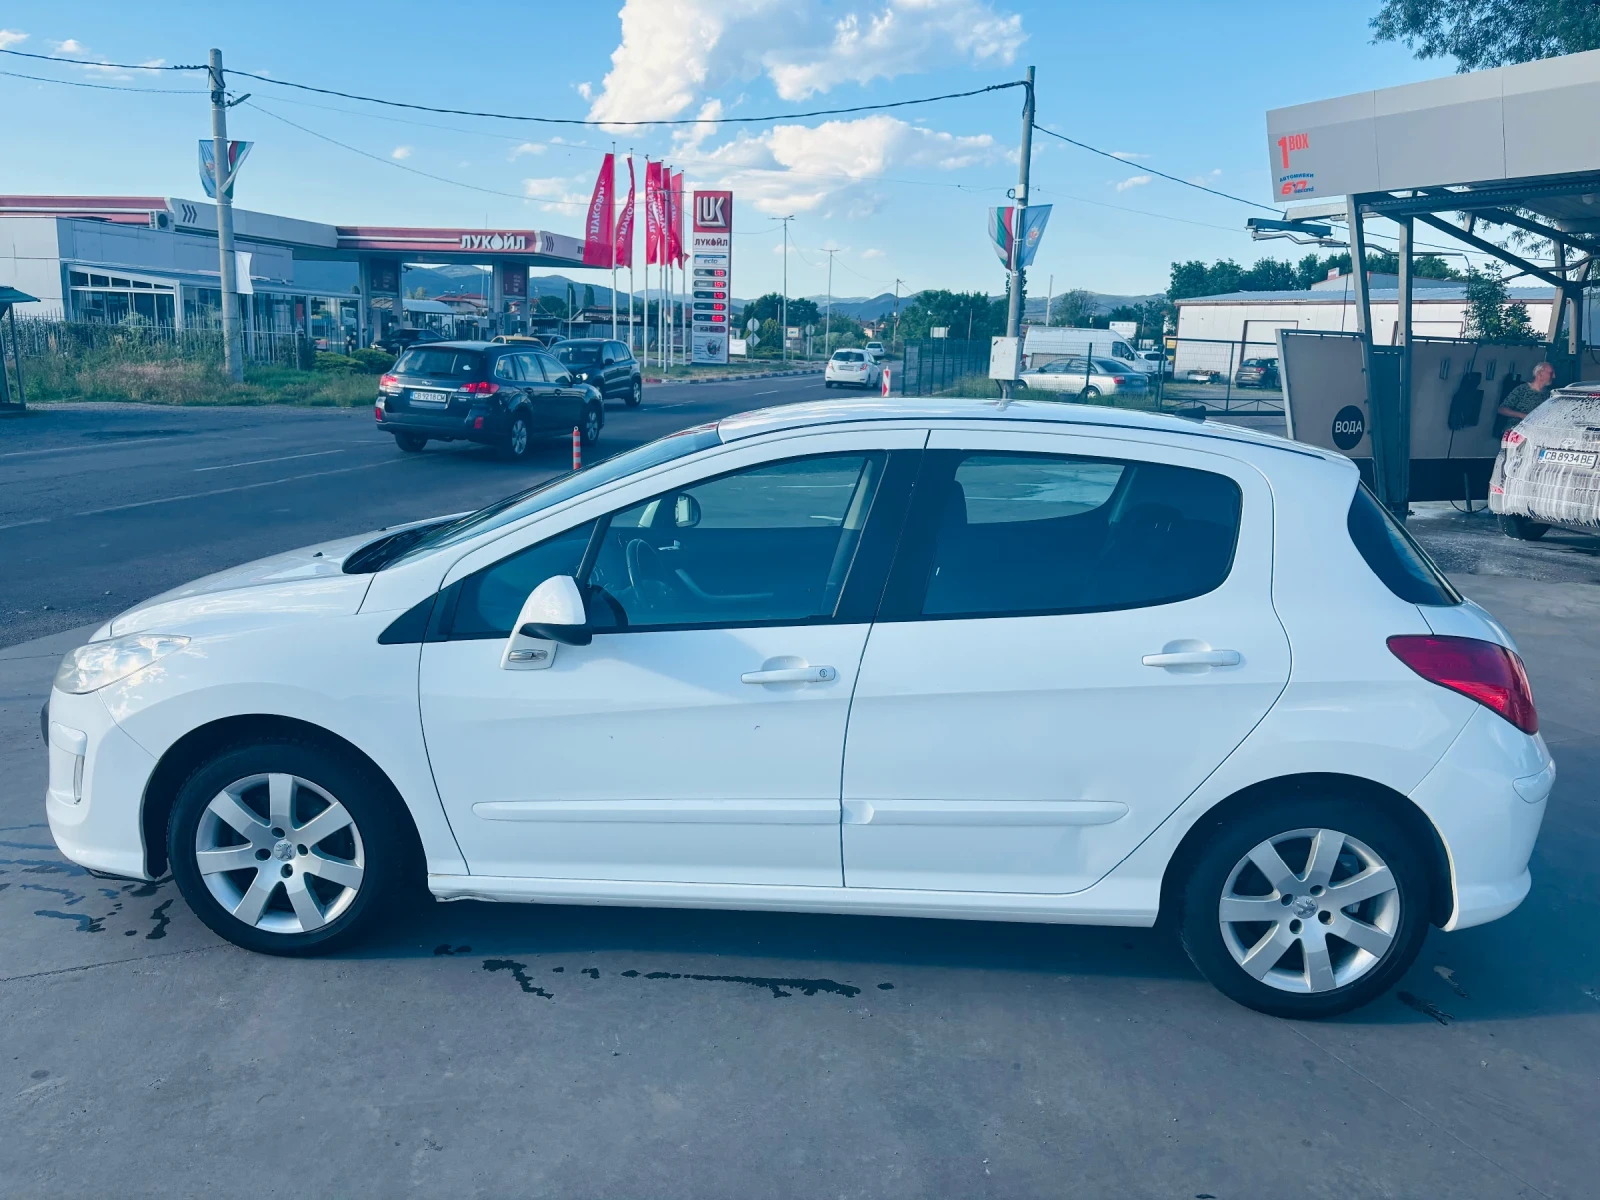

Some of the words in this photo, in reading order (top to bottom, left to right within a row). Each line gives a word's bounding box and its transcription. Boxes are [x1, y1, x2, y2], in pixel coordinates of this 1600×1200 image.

[1277, 136, 1289, 169] 1
[1288, 133, 1309, 151] BOX
[460, 232, 526, 250] ЛУКОЙЛ
[694, 238, 728, 247] ЛУКОЙЛ
[1335, 420, 1362, 435] ВОДА
[1557, 452, 1580, 463] 8934
